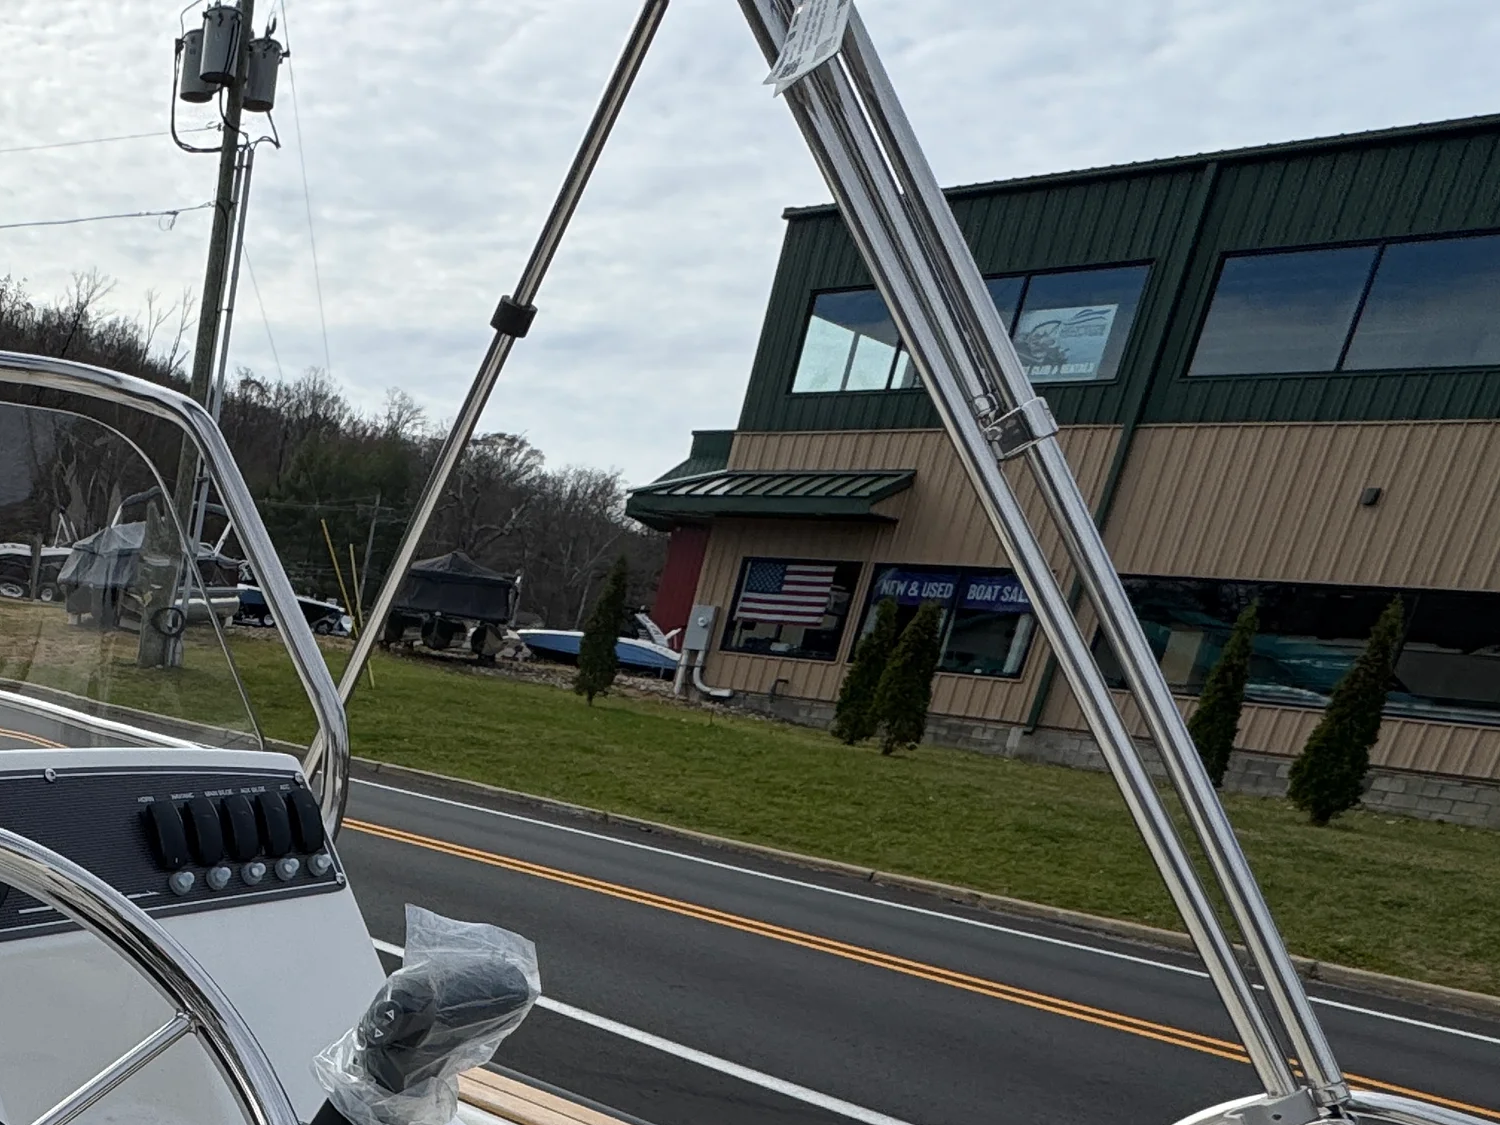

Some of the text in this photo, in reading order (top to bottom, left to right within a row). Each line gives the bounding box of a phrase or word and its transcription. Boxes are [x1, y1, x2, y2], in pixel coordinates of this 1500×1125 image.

[879, 579, 1029, 603] NEW & USED BOAT SAL
